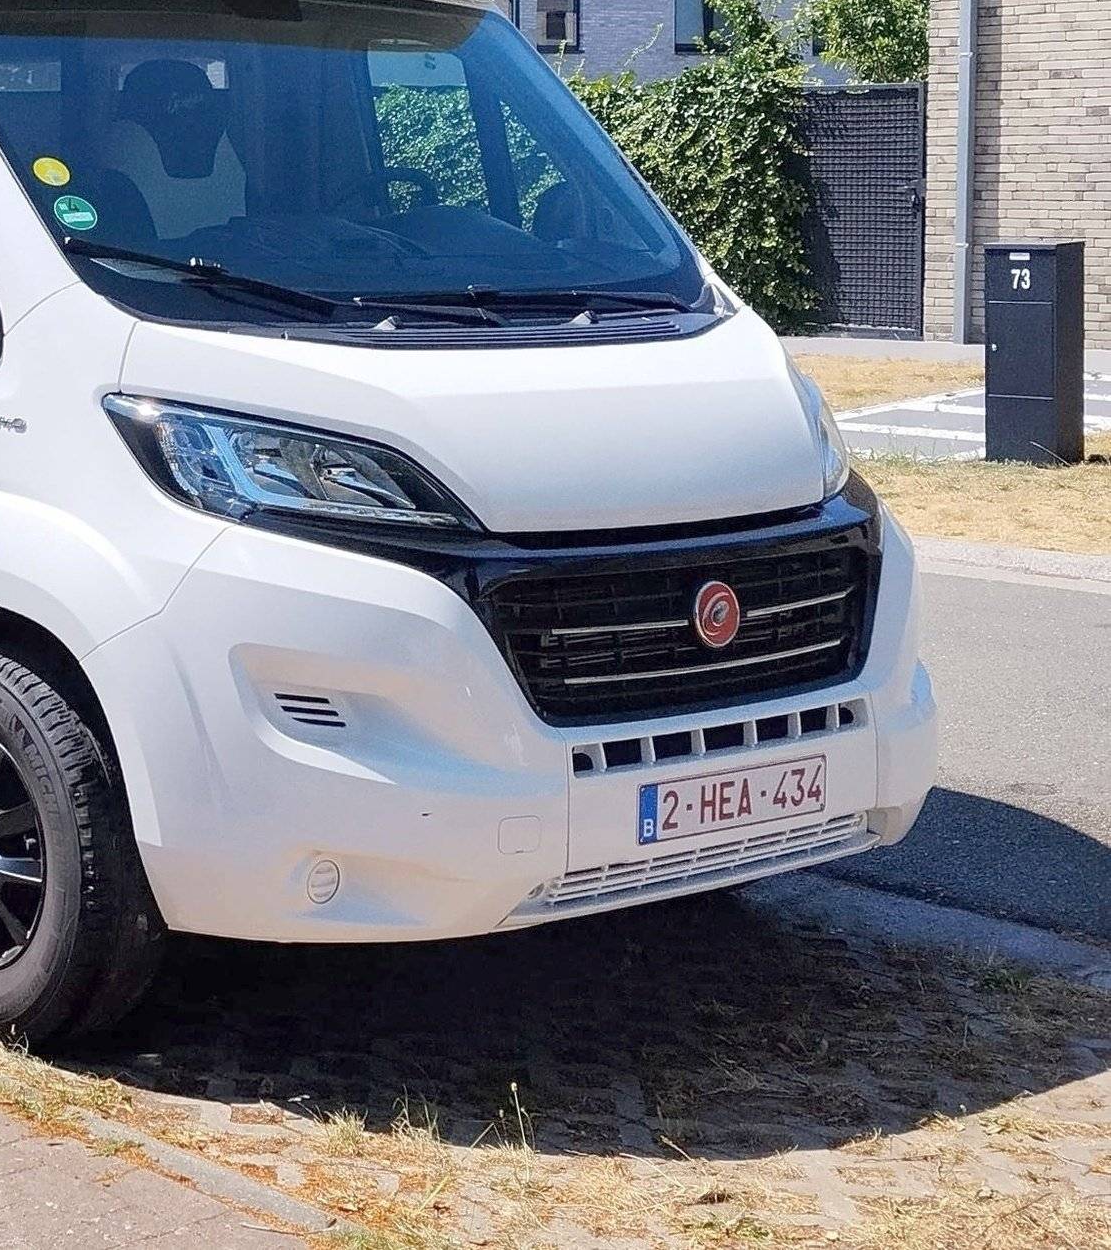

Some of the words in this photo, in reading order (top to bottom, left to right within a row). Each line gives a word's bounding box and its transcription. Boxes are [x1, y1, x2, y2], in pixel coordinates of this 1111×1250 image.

[1010, 268, 1031, 290] 73
[661, 754, 823, 831] 2-HEA-434
[643, 819, 655, 838] B
